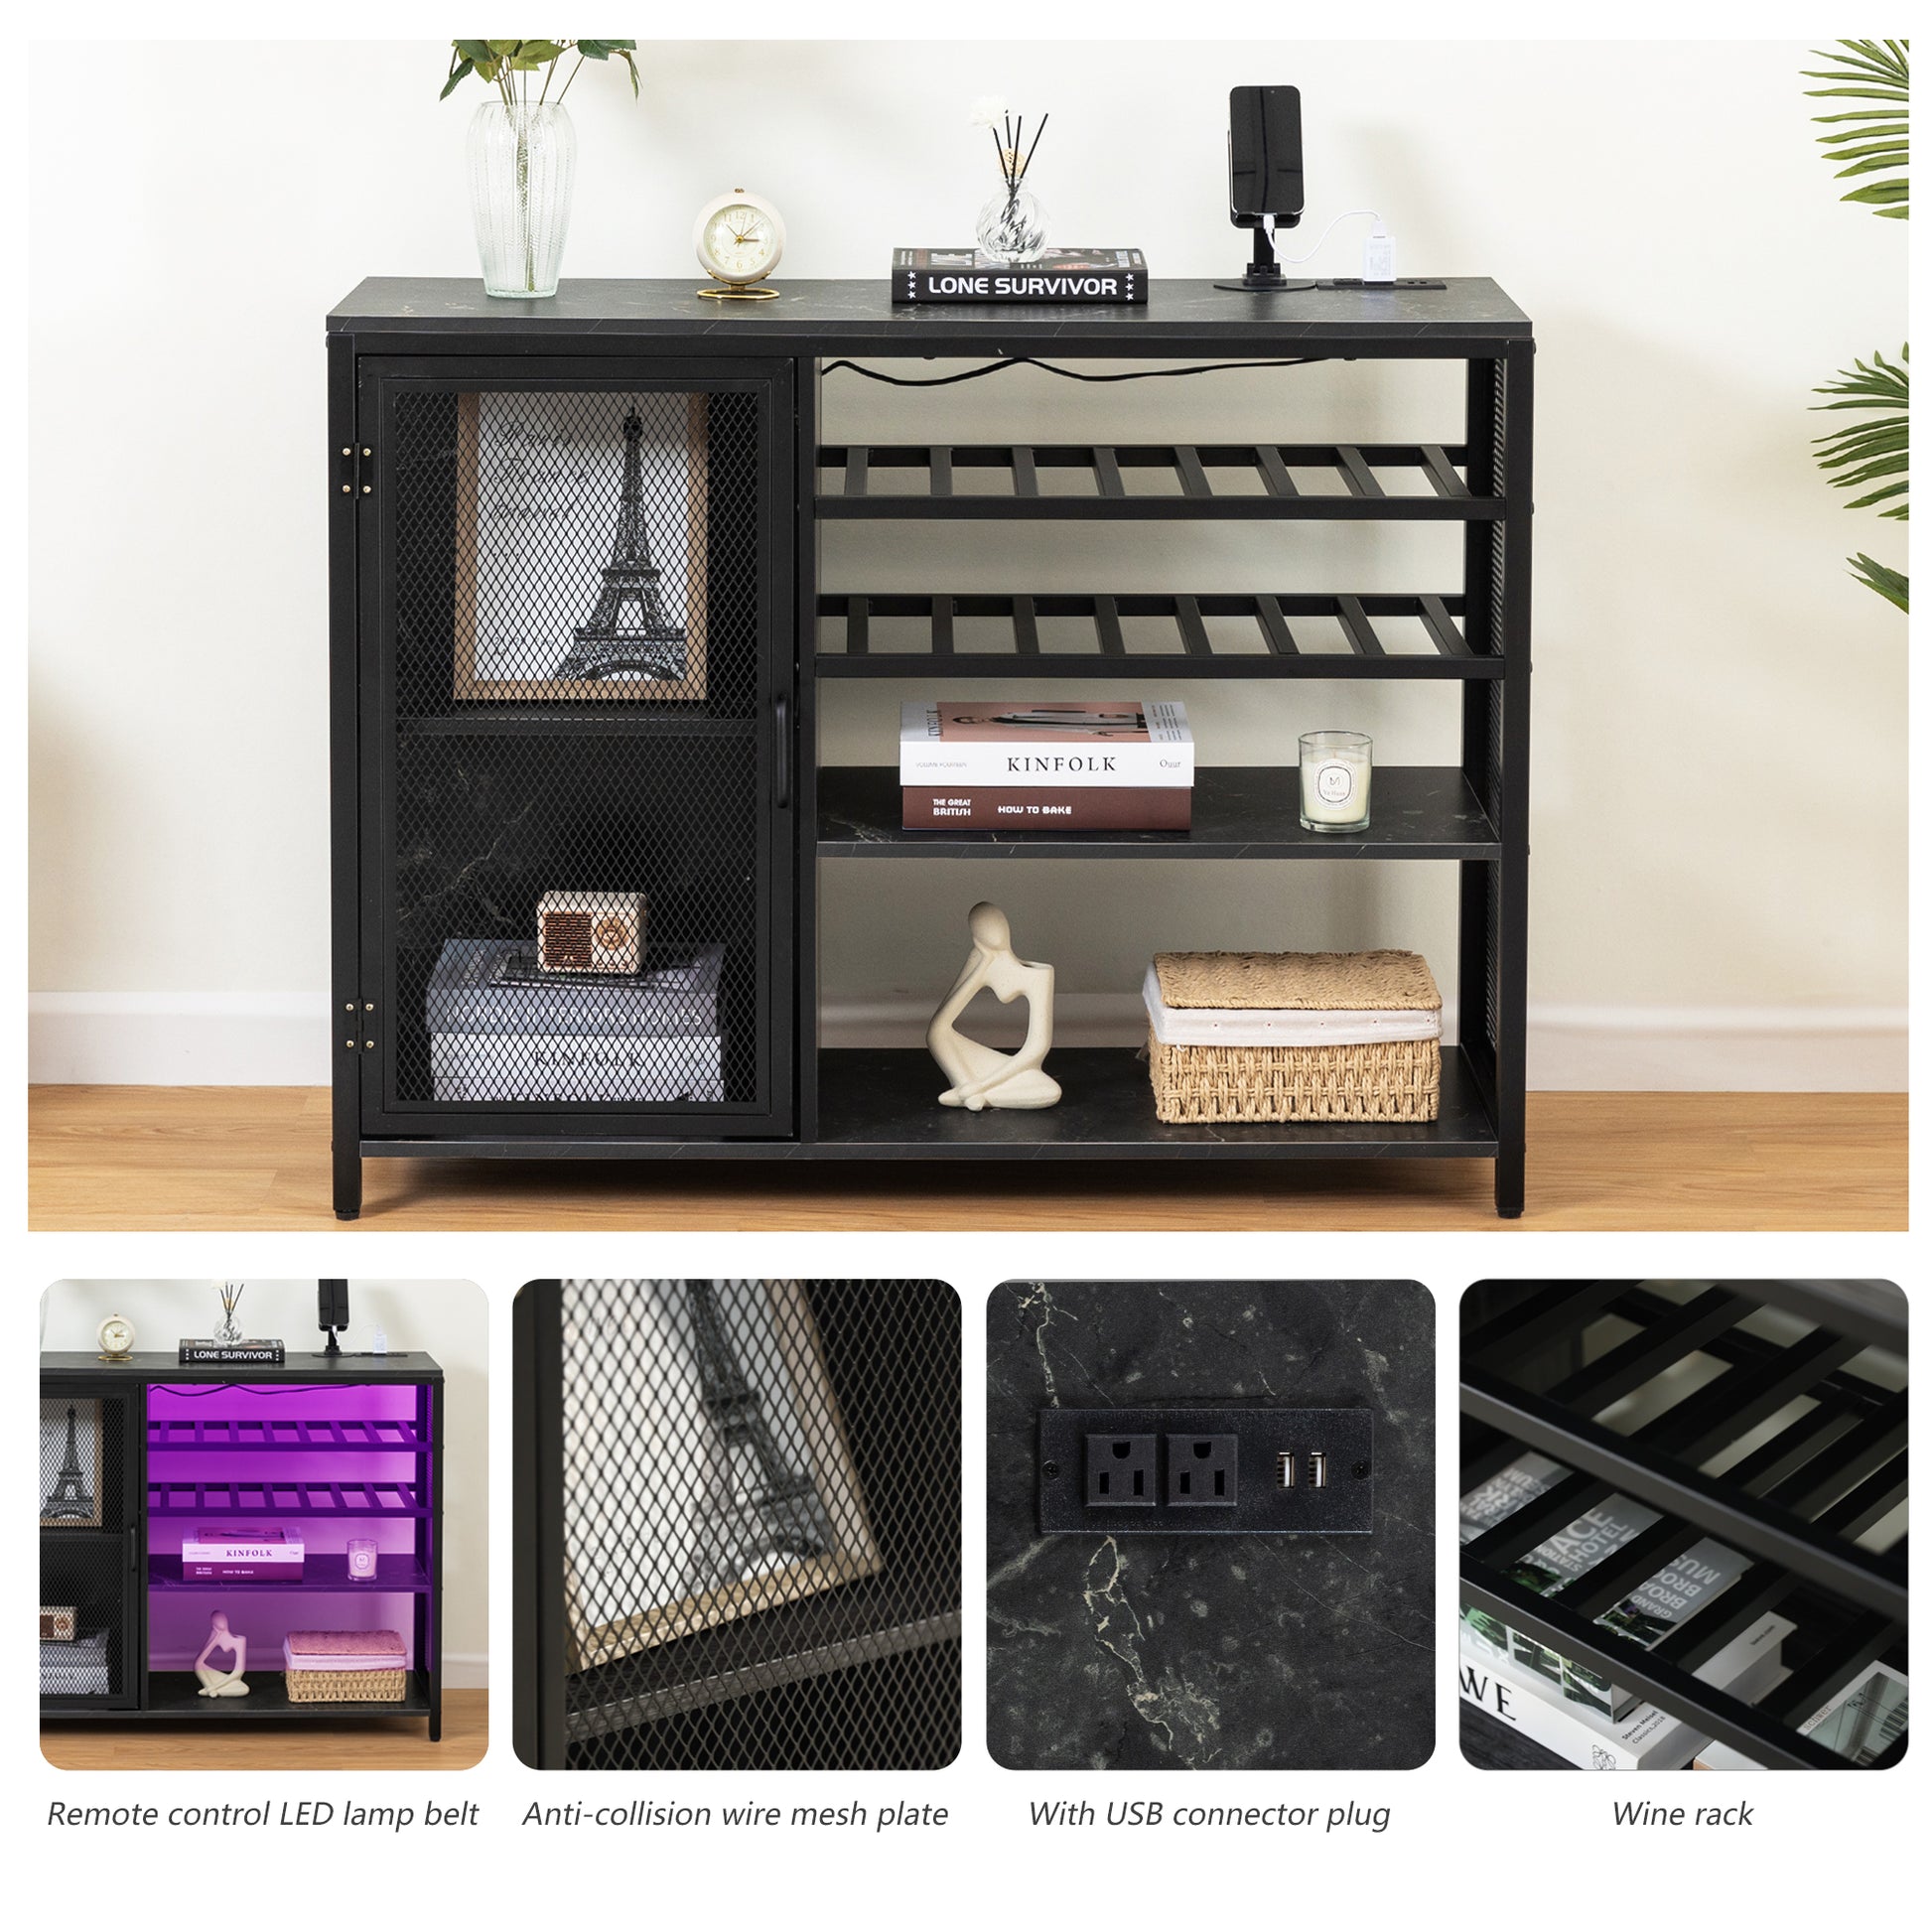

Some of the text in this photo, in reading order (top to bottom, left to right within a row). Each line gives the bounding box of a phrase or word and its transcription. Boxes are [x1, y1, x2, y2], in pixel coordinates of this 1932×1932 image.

[928, 276, 1118, 296] LONE SURVIVOR
[1007, 757, 1117, 772] KINFOLK
[932, 807, 972, 816] BRITISH
[997, 805, 1072, 815] HOW TO BAKE
[193, 1350, 273, 1360] LONE SURVIVOR
[1569, 1523, 1628, 1563] HOTEL
[225, 1549, 273, 1558] KINFOLK
[1631, 1595, 1673, 1619] GRAND
[1621, 1710, 1659, 1739] Steven Meisel
